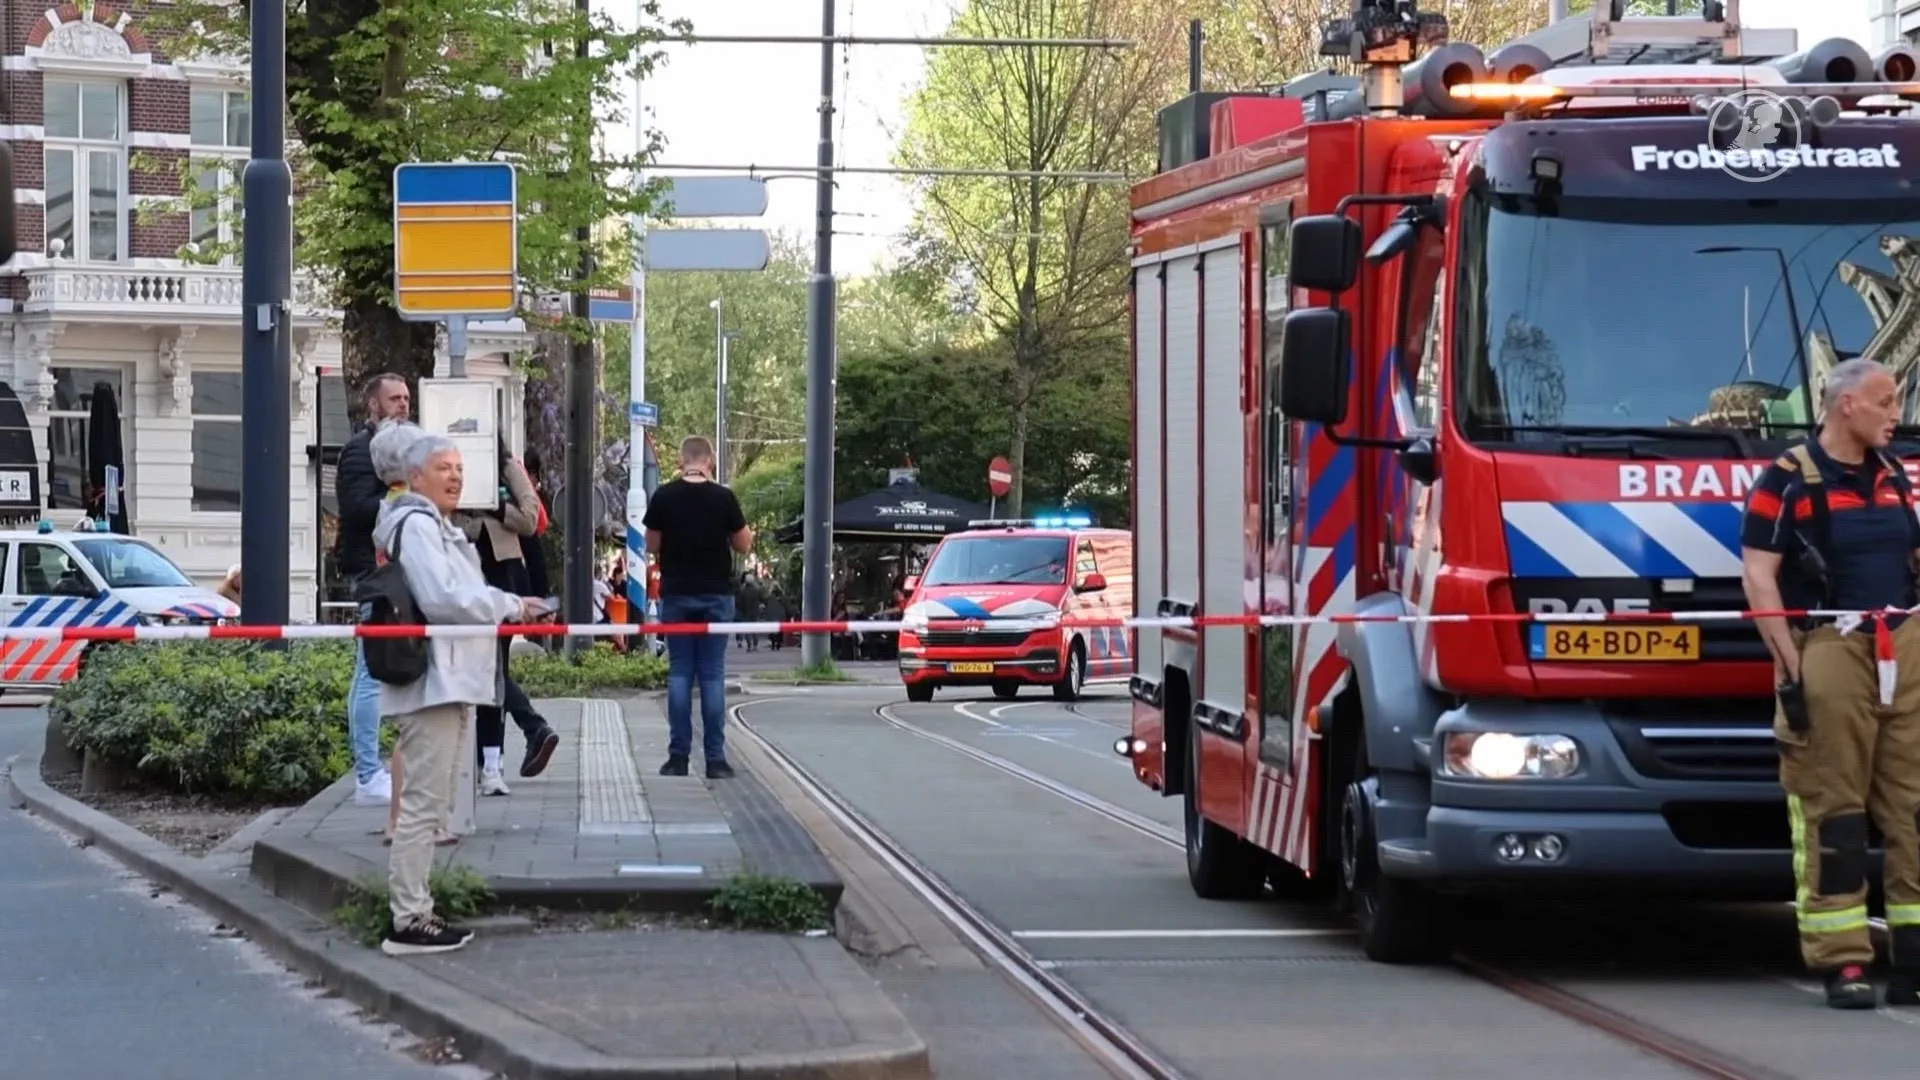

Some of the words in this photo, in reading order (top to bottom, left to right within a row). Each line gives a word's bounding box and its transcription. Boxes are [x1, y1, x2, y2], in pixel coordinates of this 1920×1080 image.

[1631, 143, 1900, 171] Frobenstraat
[1619, 464, 1763, 497] BRAN
[1554, 630, 1690, 655] 84-BDP-4
